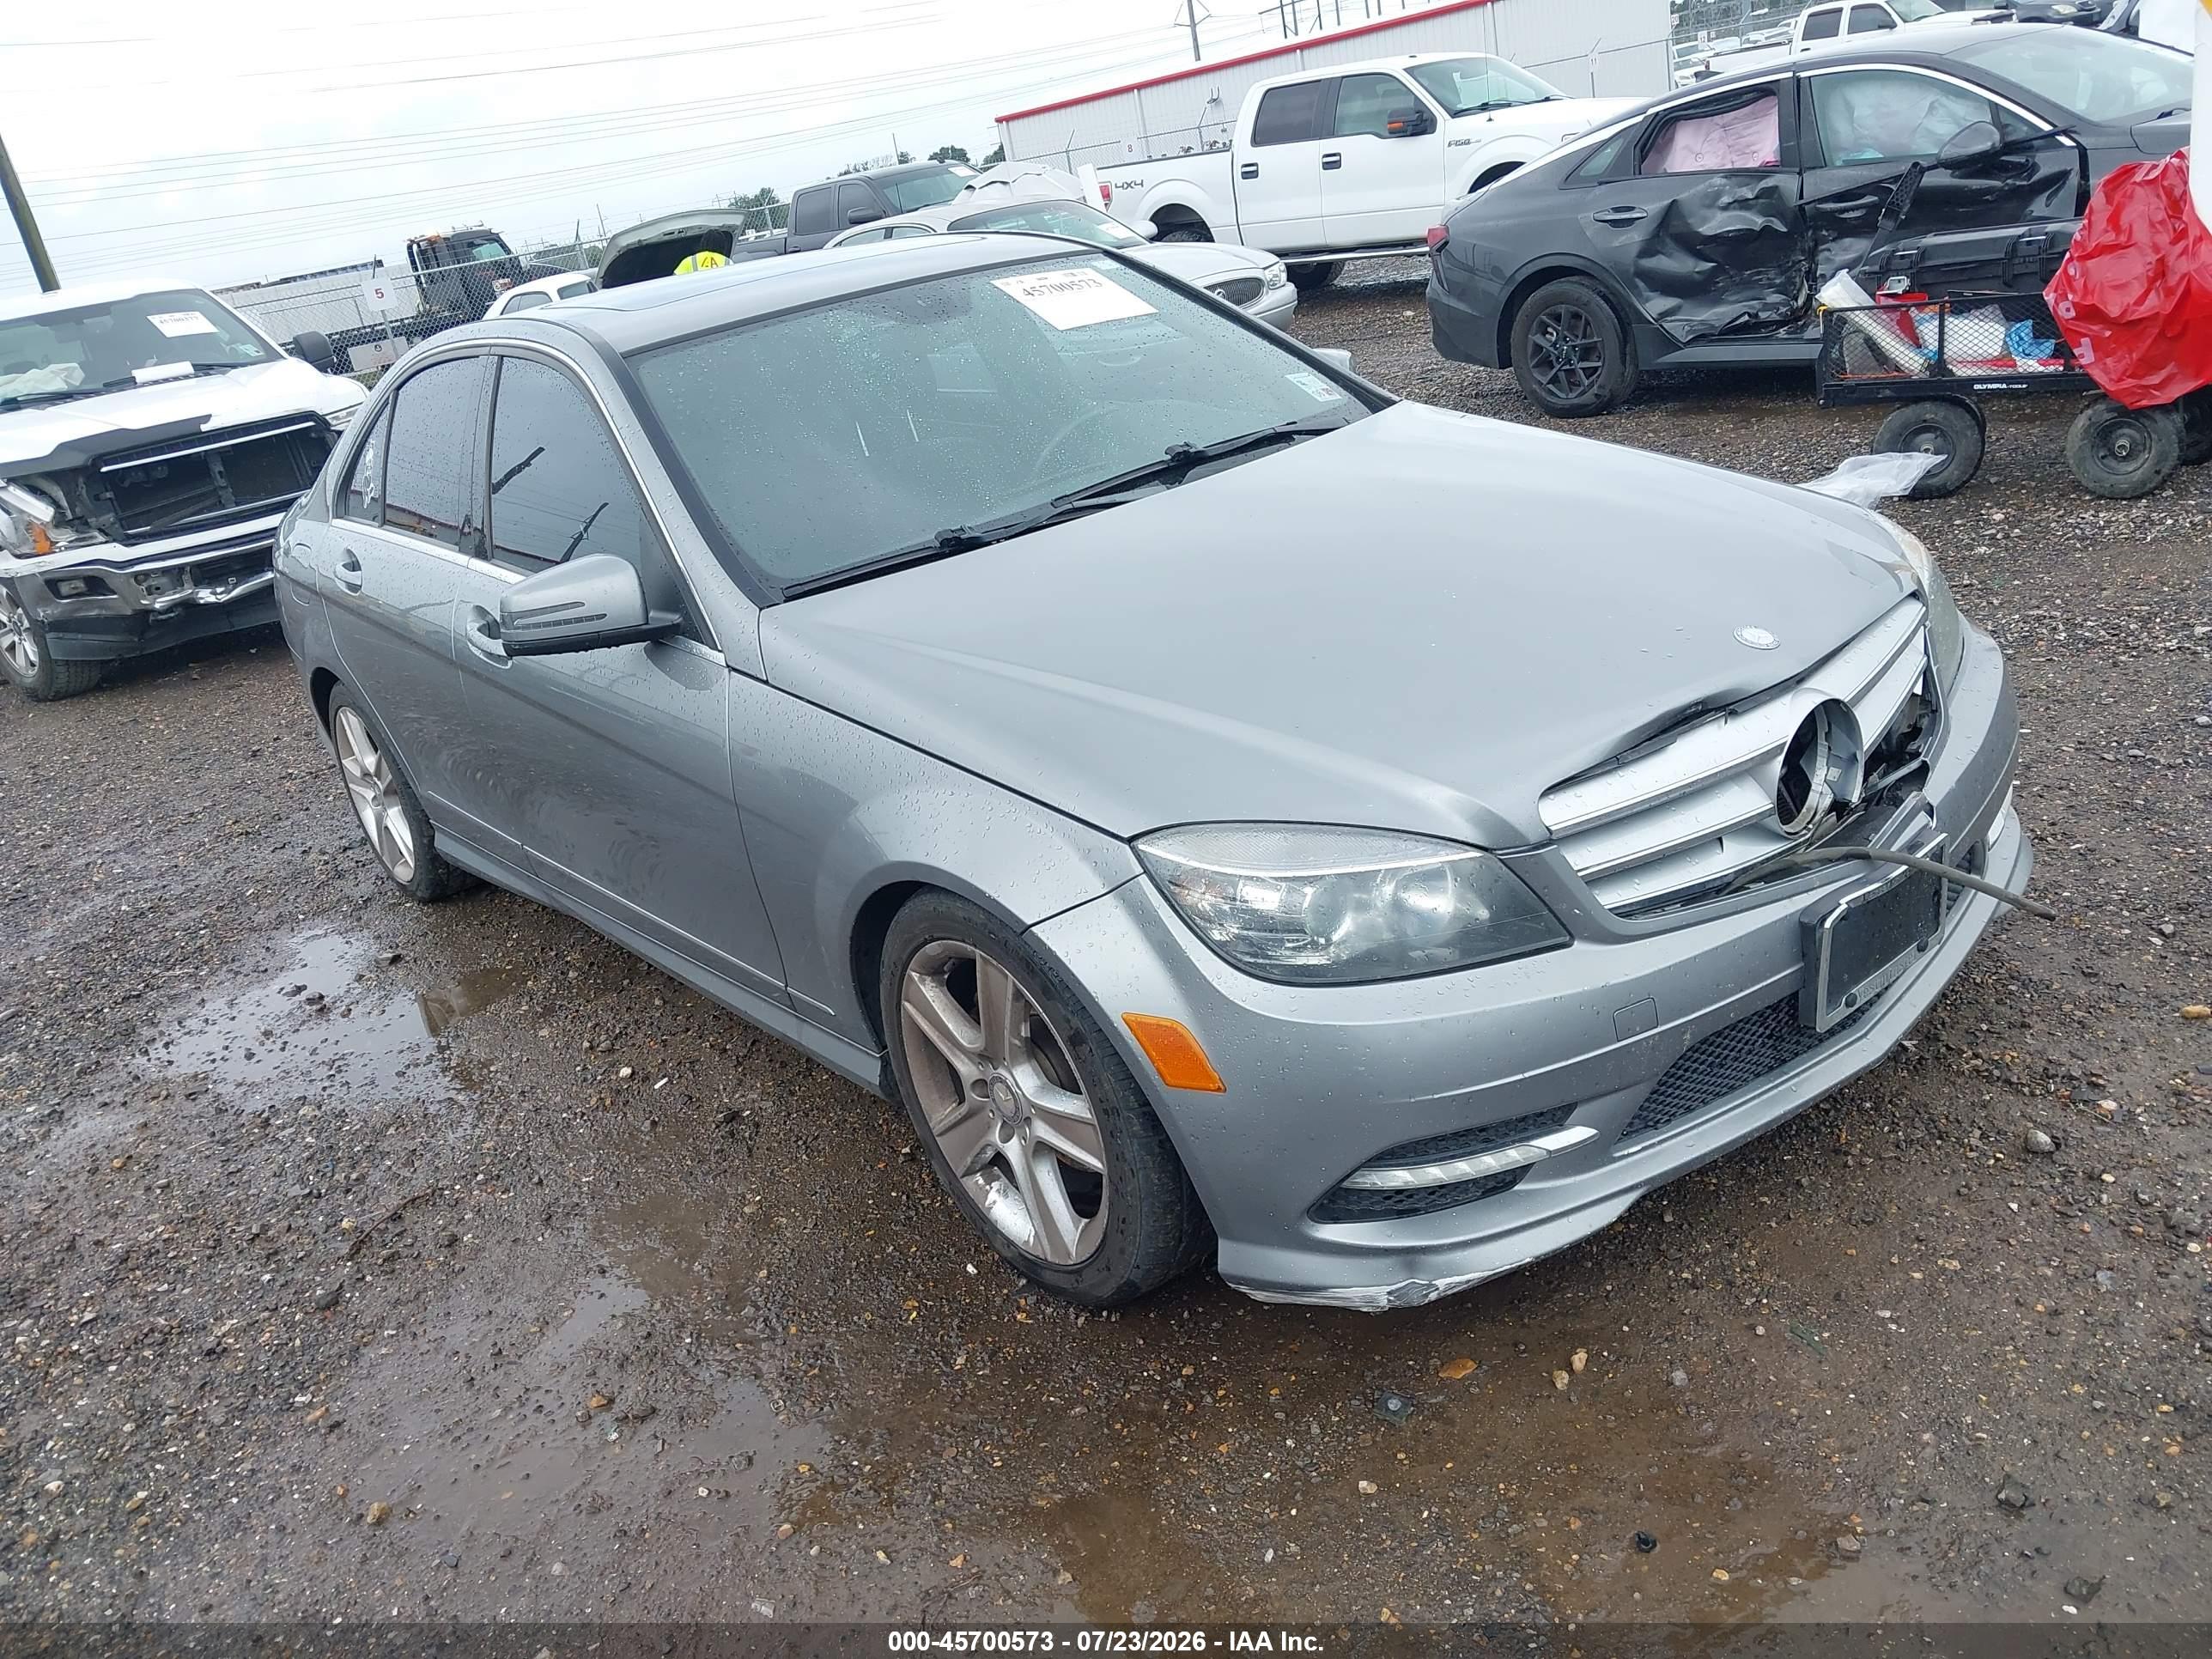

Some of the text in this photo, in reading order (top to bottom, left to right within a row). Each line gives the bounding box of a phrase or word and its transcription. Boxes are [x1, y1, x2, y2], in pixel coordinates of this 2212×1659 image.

[1127, 143, 1133, 153] 8
[1022, 278, 1103, 296] 45700573
[374, 288, 385, 299] 5
